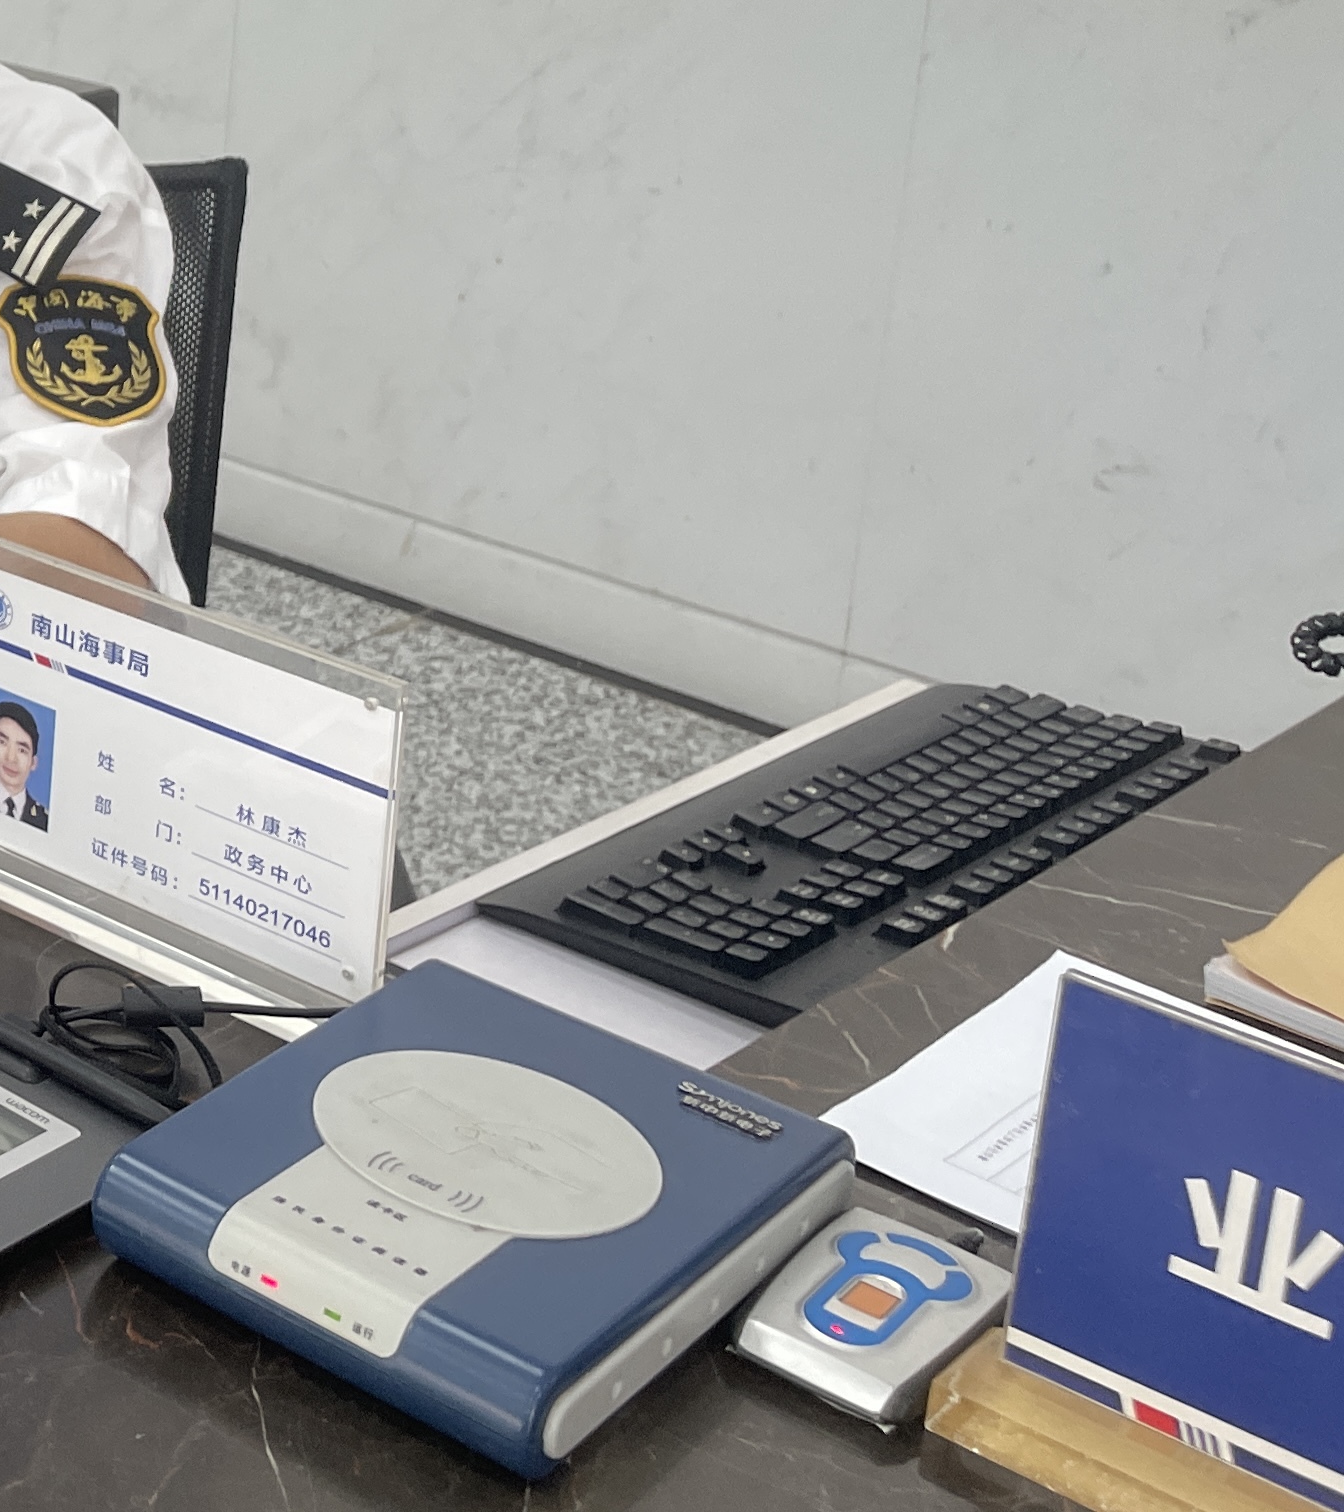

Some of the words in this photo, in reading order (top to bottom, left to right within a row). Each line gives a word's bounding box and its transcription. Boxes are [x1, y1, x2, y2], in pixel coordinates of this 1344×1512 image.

[30, 612, 150, 678] 南山海事局
[235, 803, 308, 849] 林康杰
[223, 843, 313, 896] 政务中心
[198, 877, 332, 949] 51140217046
[407, 1173, 443, 1192] card
[1167, 1168, 1344, 1341] 业
